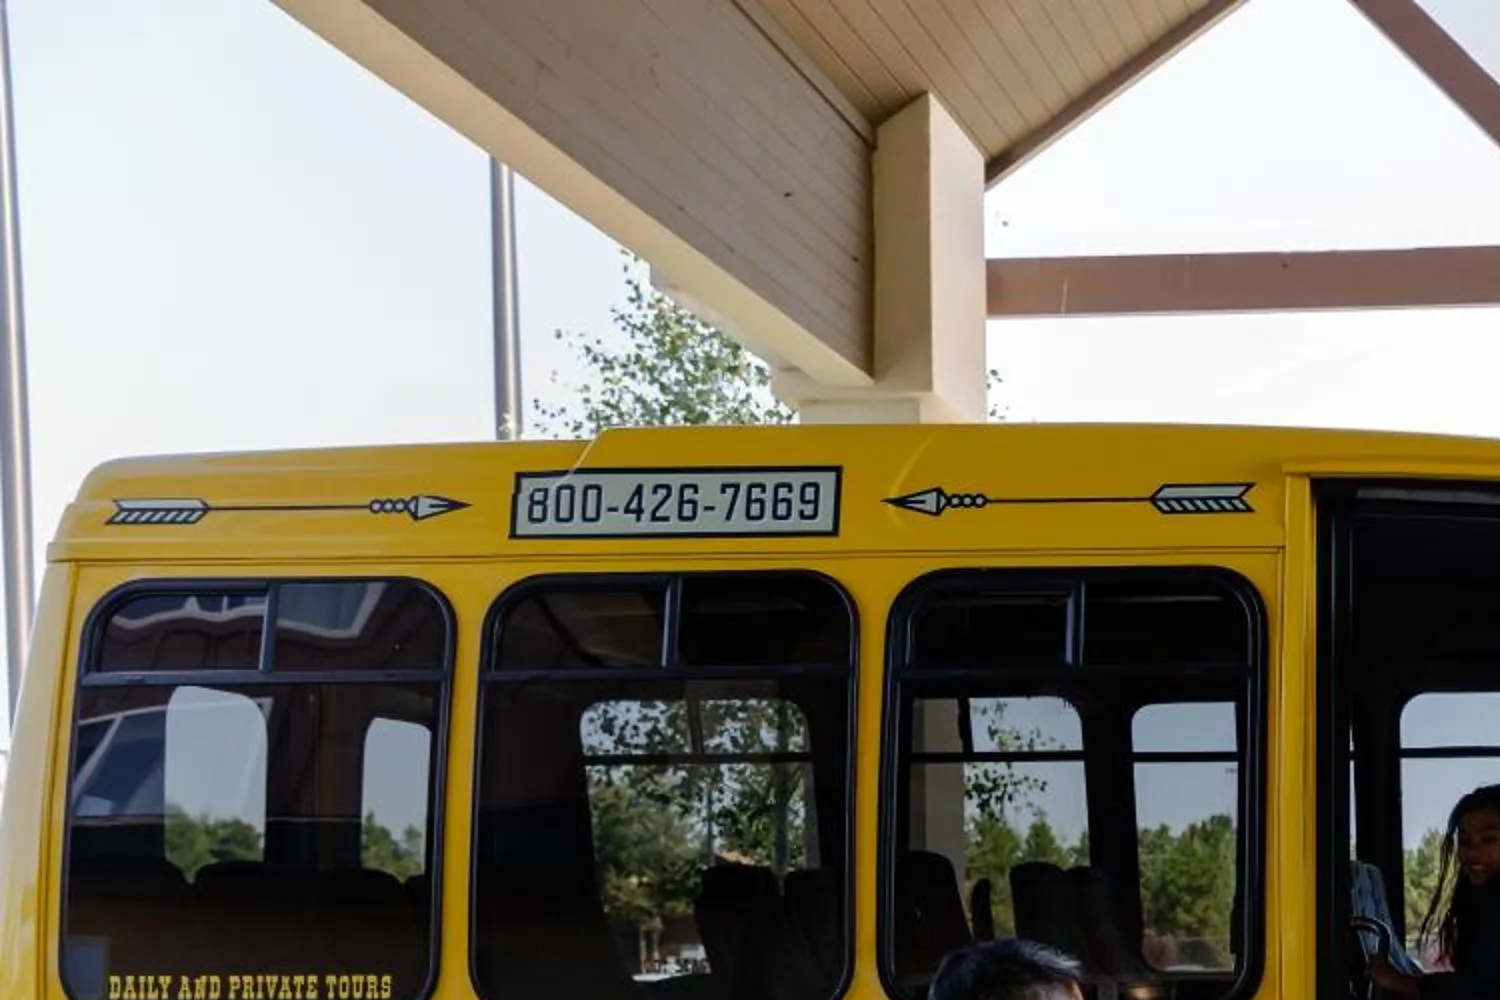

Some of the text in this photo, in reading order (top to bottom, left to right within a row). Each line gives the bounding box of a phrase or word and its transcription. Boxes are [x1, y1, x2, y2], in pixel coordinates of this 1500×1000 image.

[527, 481, 822, 523] 800-426-7669
[109, 974, 392, 1000] DAILY AND PRIVATE TOURS
